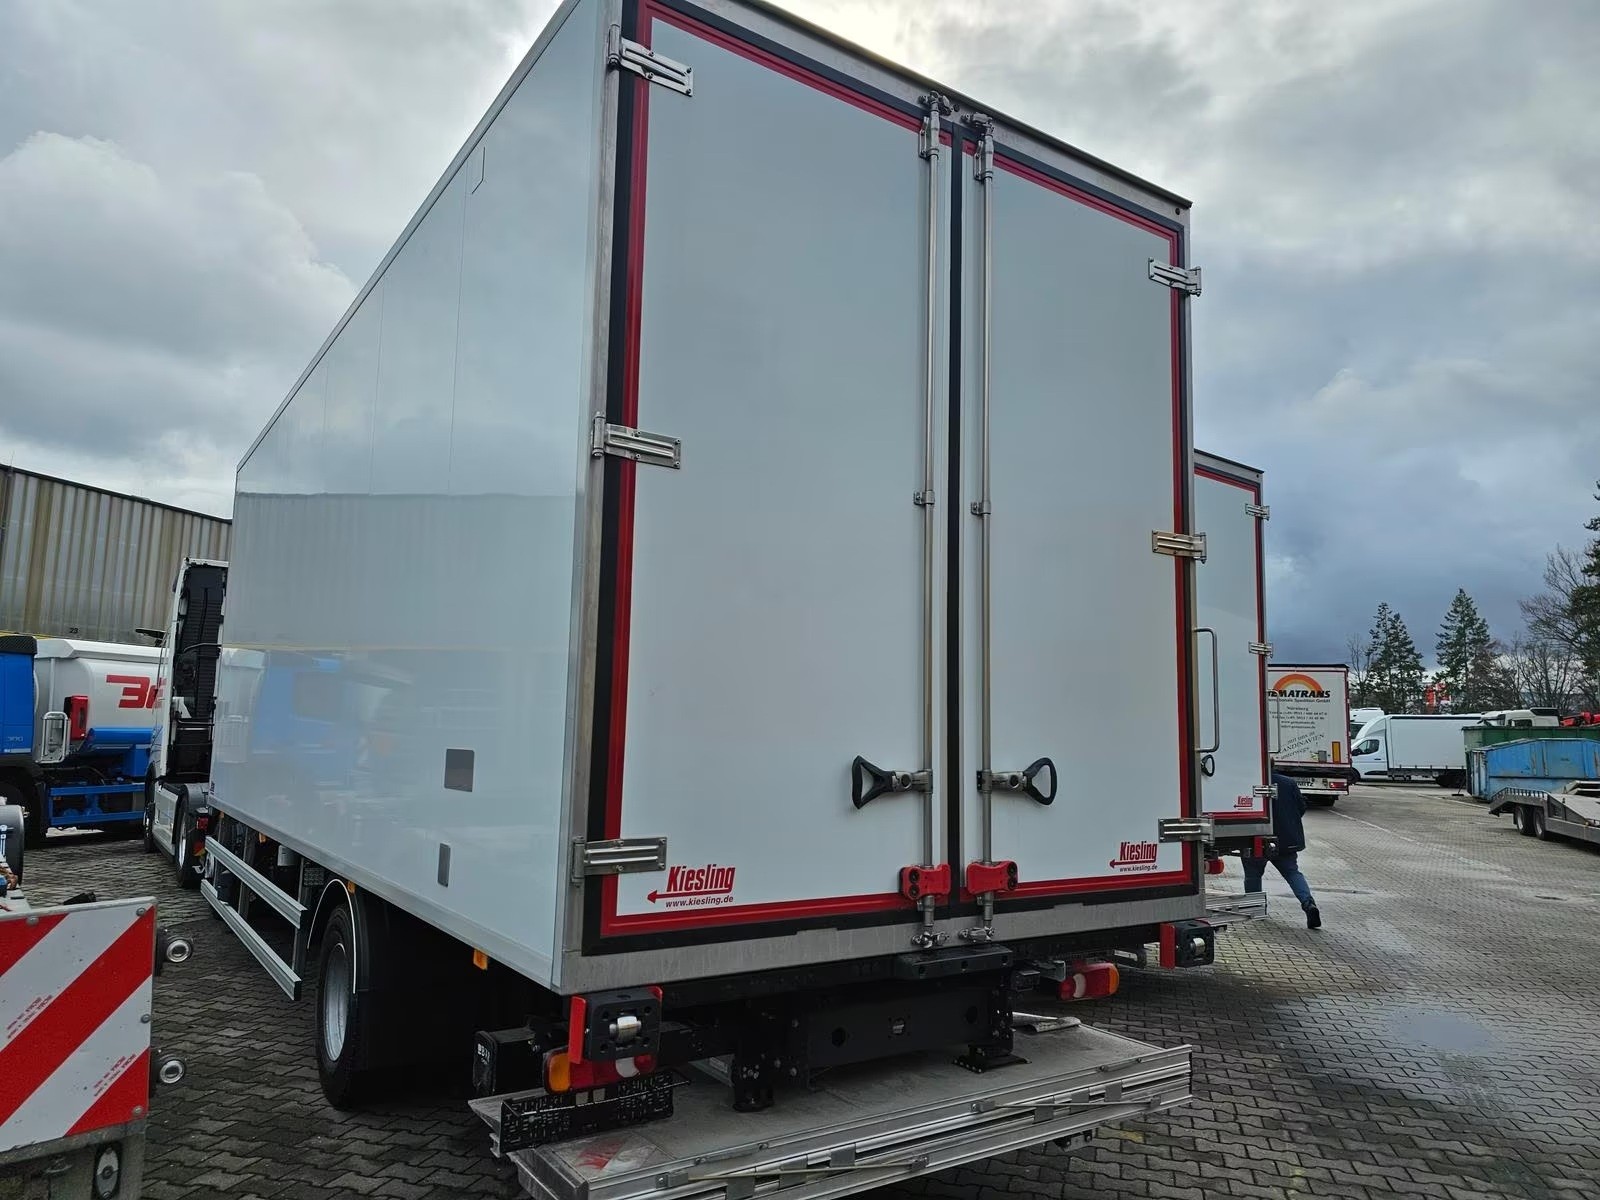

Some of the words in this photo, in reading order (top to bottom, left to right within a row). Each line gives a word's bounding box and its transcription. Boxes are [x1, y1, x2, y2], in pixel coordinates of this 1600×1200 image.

[1119, 841, 1158, 862] Kiesling
[1119, 864, 1158, 872] www.kiesling.de
[666, 864, 736, 893] Kiesling
[665, 895, 734, 908] www.kiesling.de
